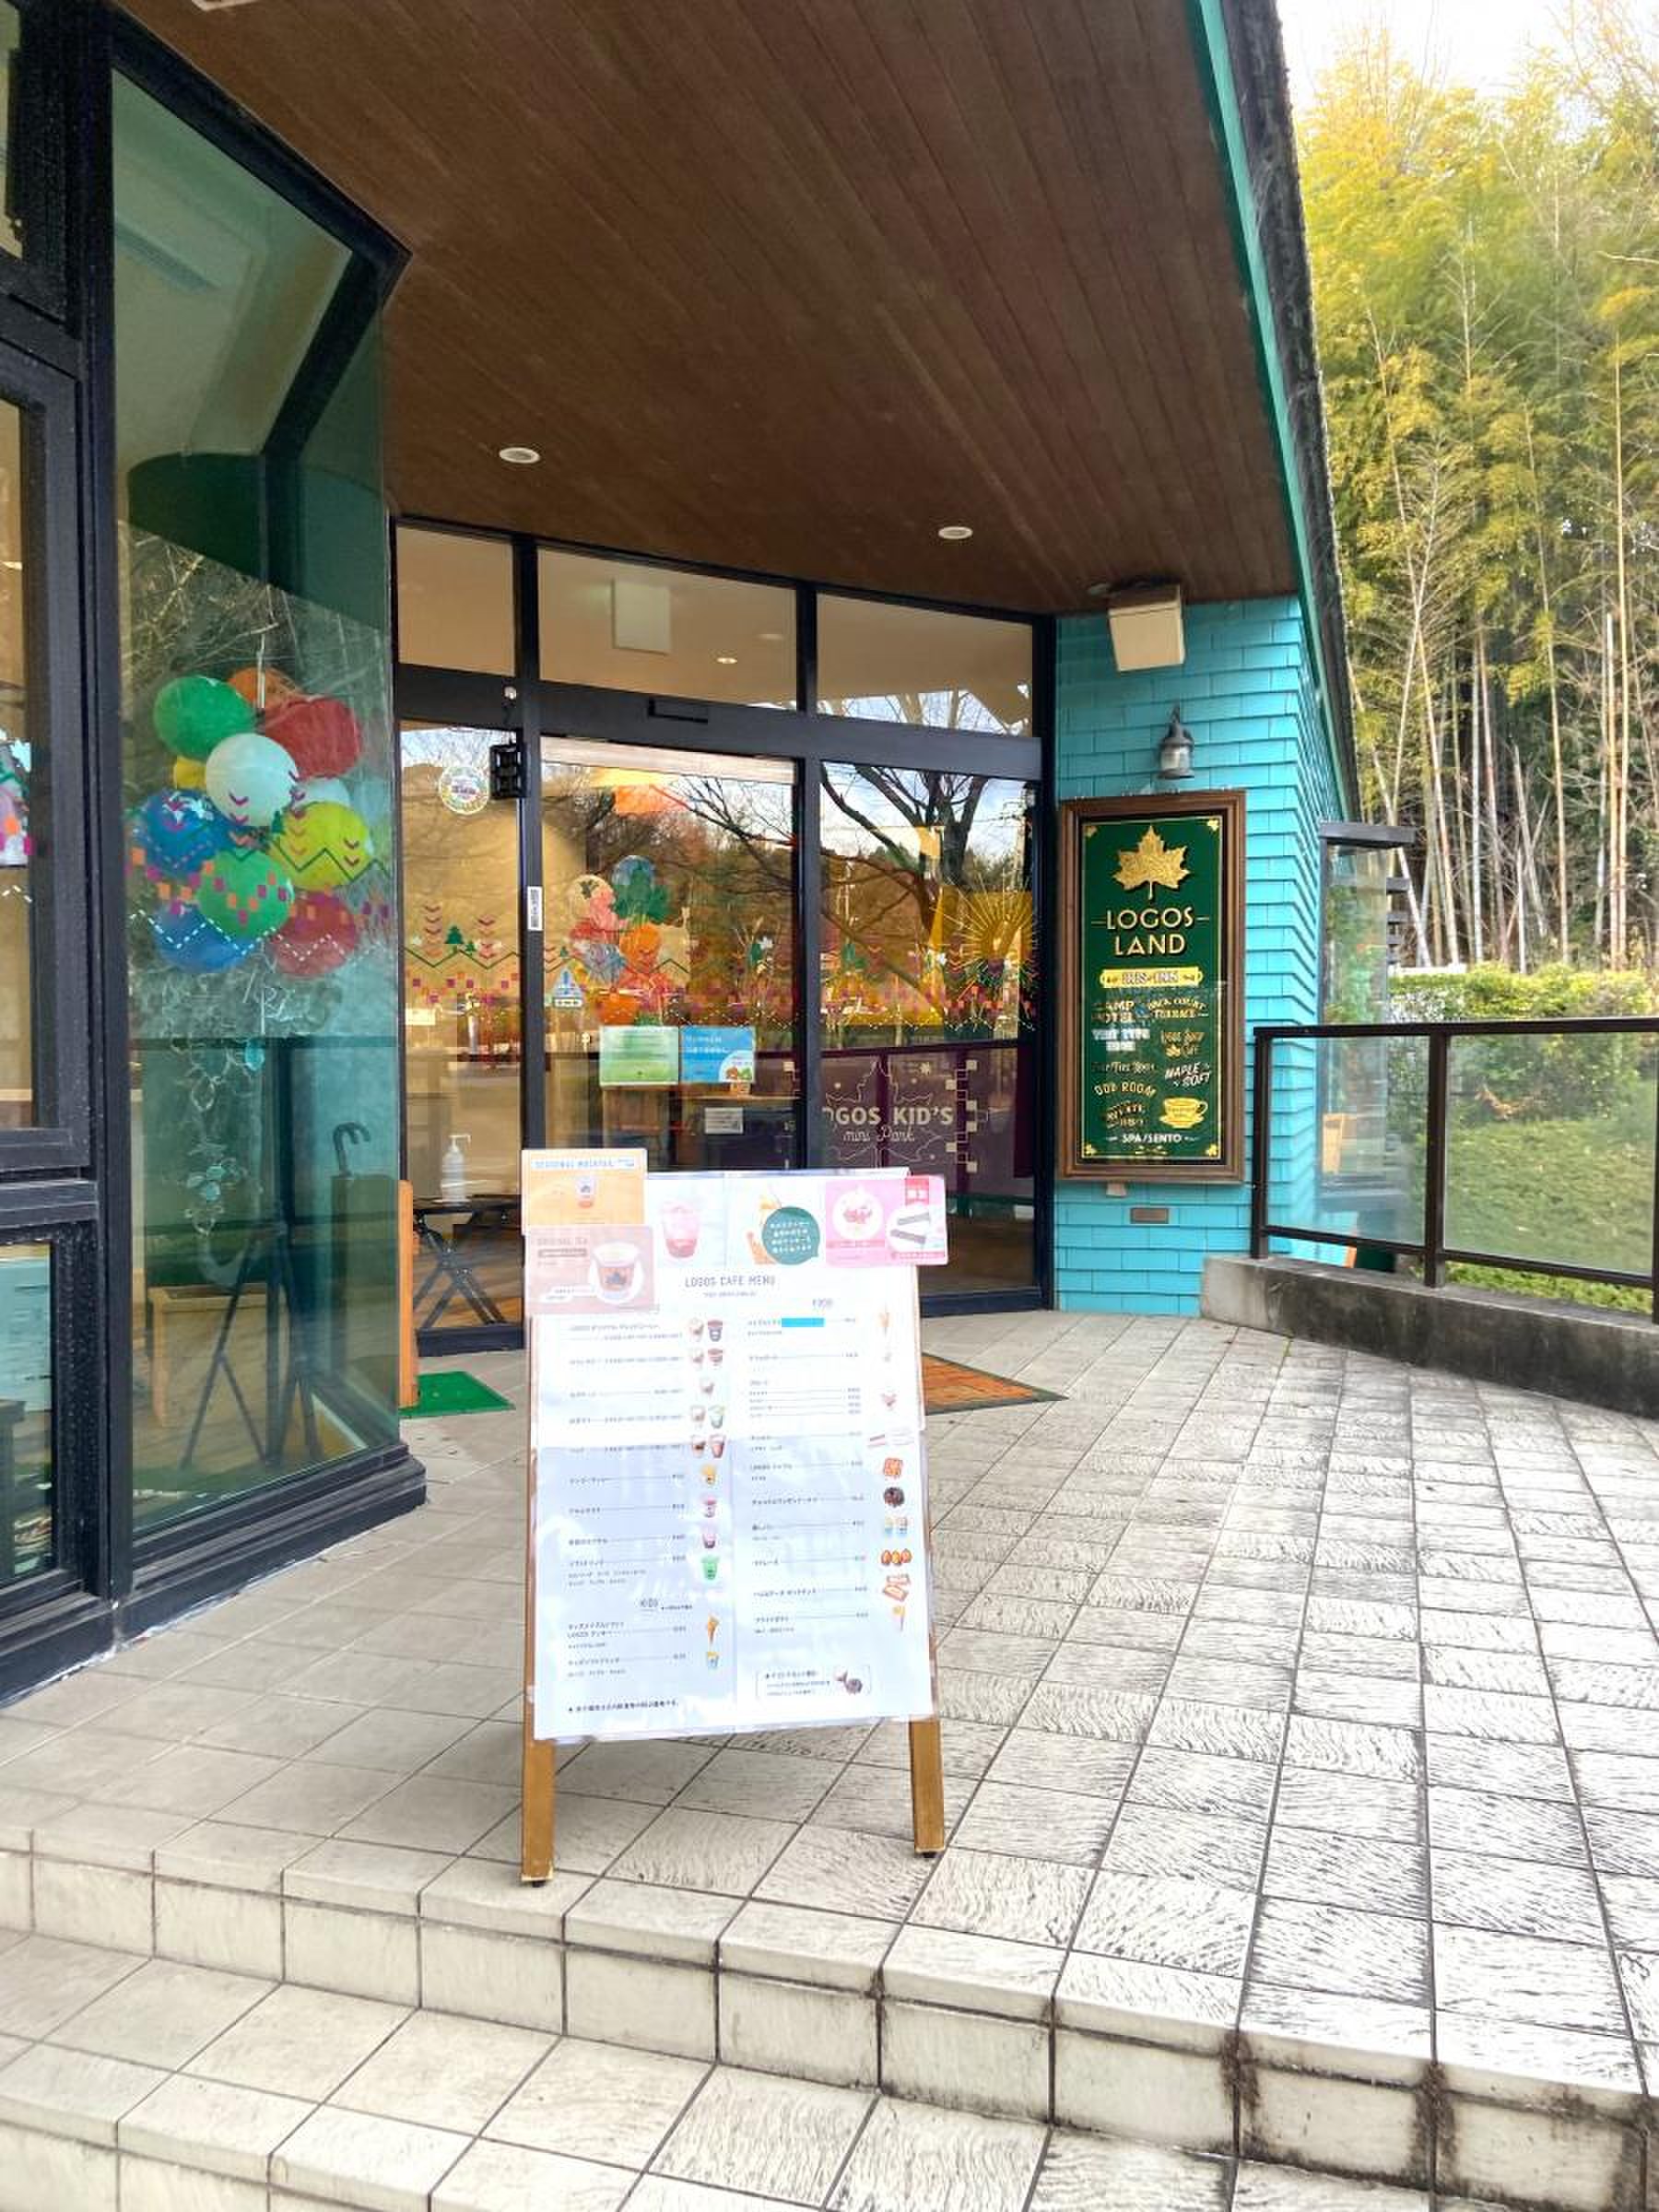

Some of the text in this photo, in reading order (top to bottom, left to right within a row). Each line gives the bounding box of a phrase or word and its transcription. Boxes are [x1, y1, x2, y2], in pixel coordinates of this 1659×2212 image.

[1106, 906, 1194, 931] LOGOS
[1114, 933, 1186, 957] LAND
[893, 1107, 953, 1125] KID'S
[1122, 1134, 1182, 1144] SPA/SENTO
